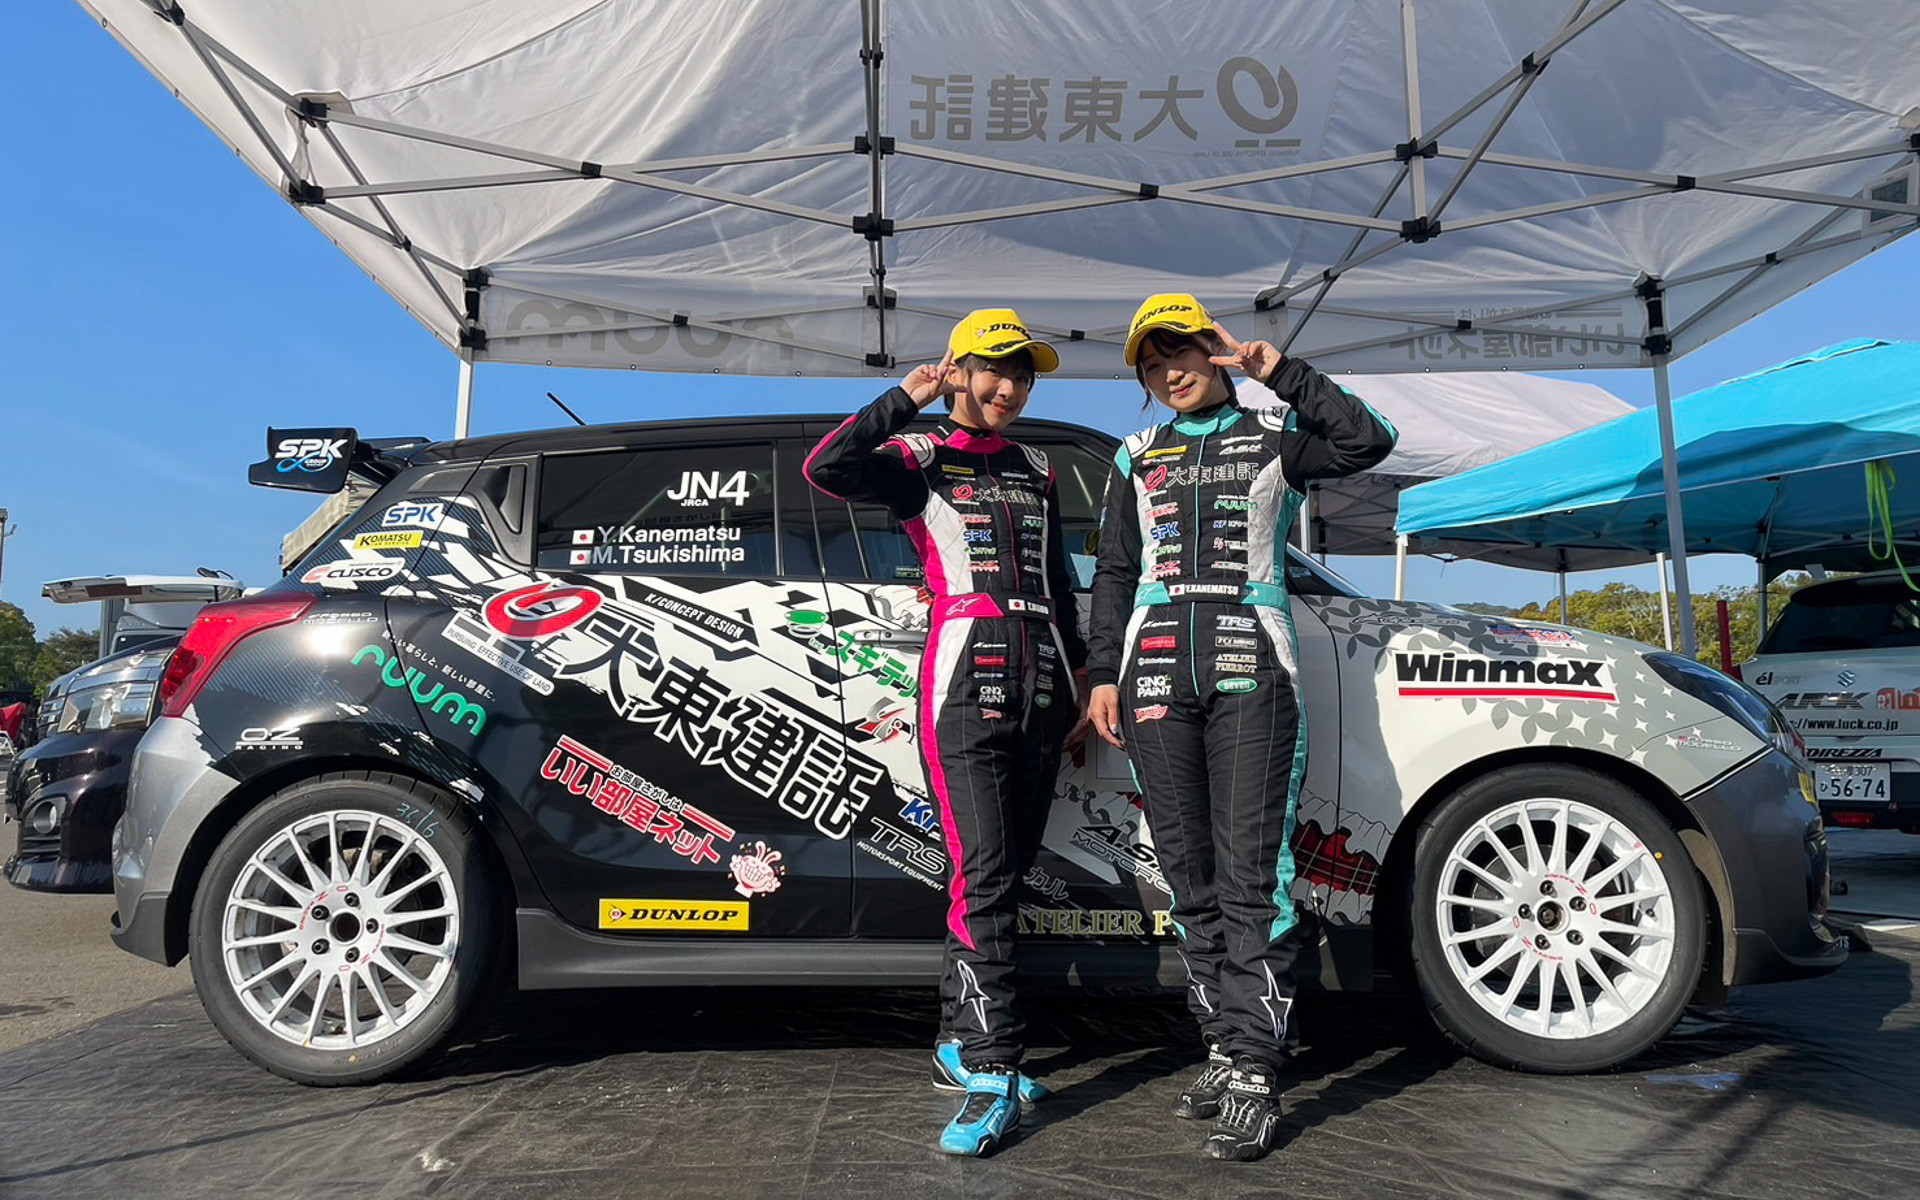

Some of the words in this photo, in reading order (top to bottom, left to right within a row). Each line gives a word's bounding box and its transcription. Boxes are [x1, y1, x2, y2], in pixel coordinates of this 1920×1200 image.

[274, 438, 349, 459] SPK
[667, 471, 750, 506] JN4
[681, 499, 709, 507] JRCA
[385, 505, 439, 524] SPK
[360, 533, 412, 546] KOMATSU
[598, 525, 741, 543] Y.Kanematsu
[592, 544, 745, 564] M.Tsukishima
[327, 567, 393, 578] CUSCO
[644, 593, 705, 621] K/CONCEPT
[704, 614, 745, 639] DESIGN
[446, 628, 476, 650] PURSUING
[477, 645, 510, 669] EFFECTIVE
[509, 663, 524, 676] USE
[522, 671, 534, 681] OF
[532, 677, 551, 693] LAND
[1396, 652, 1604, 687] Winmax
[553, 614, 885, 840] 大東建託
[609, 764, 683, 812] お部屋さがしは
[1830, 779, 1886, 798] 56-74
[540, 747, 721, 865] いい部屋ネット
[870, 816, 947, 875] TRS
[629, 909, 738, 921] DUNLOP
